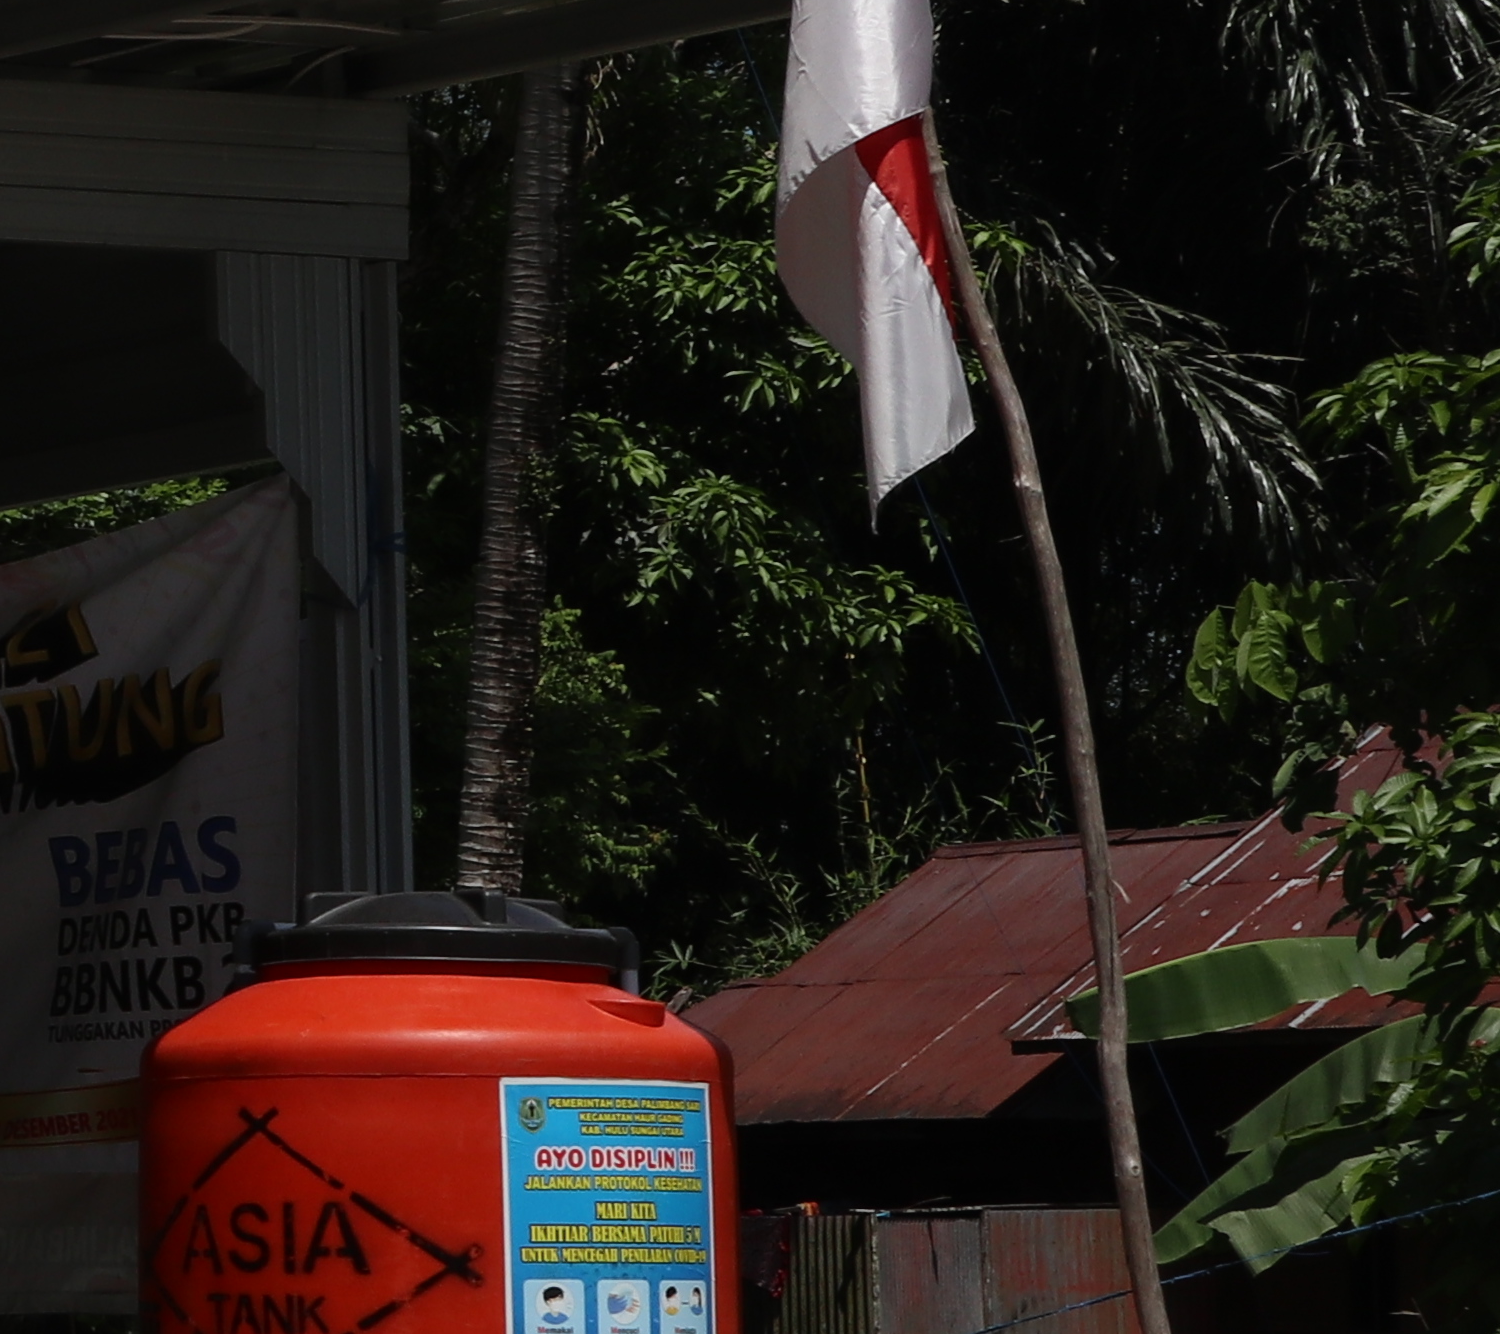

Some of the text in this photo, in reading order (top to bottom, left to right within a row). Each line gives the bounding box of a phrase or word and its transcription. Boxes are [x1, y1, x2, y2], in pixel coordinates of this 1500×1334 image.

[48, 815, 241, 907] BEBAS
[58, 902, 244, 956] DENDA PKB
[50, 955, 206, 1017] BBNKB
[48, 1021, 145, 1042] TUNGGAKAN
[548, 1097, 613, 1109] PEMERINTAH
[615, 1098, 640, 1109] DESA
[3, 1109, 91, 1140] DESEMBER
[94, 1105, 138, 1132] 2021
[536, 1148, 694, 1170] AYO DISIPLIN !!!
[524, 1175, 702, 1192] JALANKAN PROTOKOL KESEHATAN
[595, 1201, 657, 1220] MARI KITA
[184, 1200, 372, 1277] ASIA
[529, 1224, 589, 1243] IKHTIAR
[590, 1225, 648, 1244] BERSAMA
[520, 1247, 559, 1263] UNTUK
[561, 1247, 619, 1263] MENCEGAH
